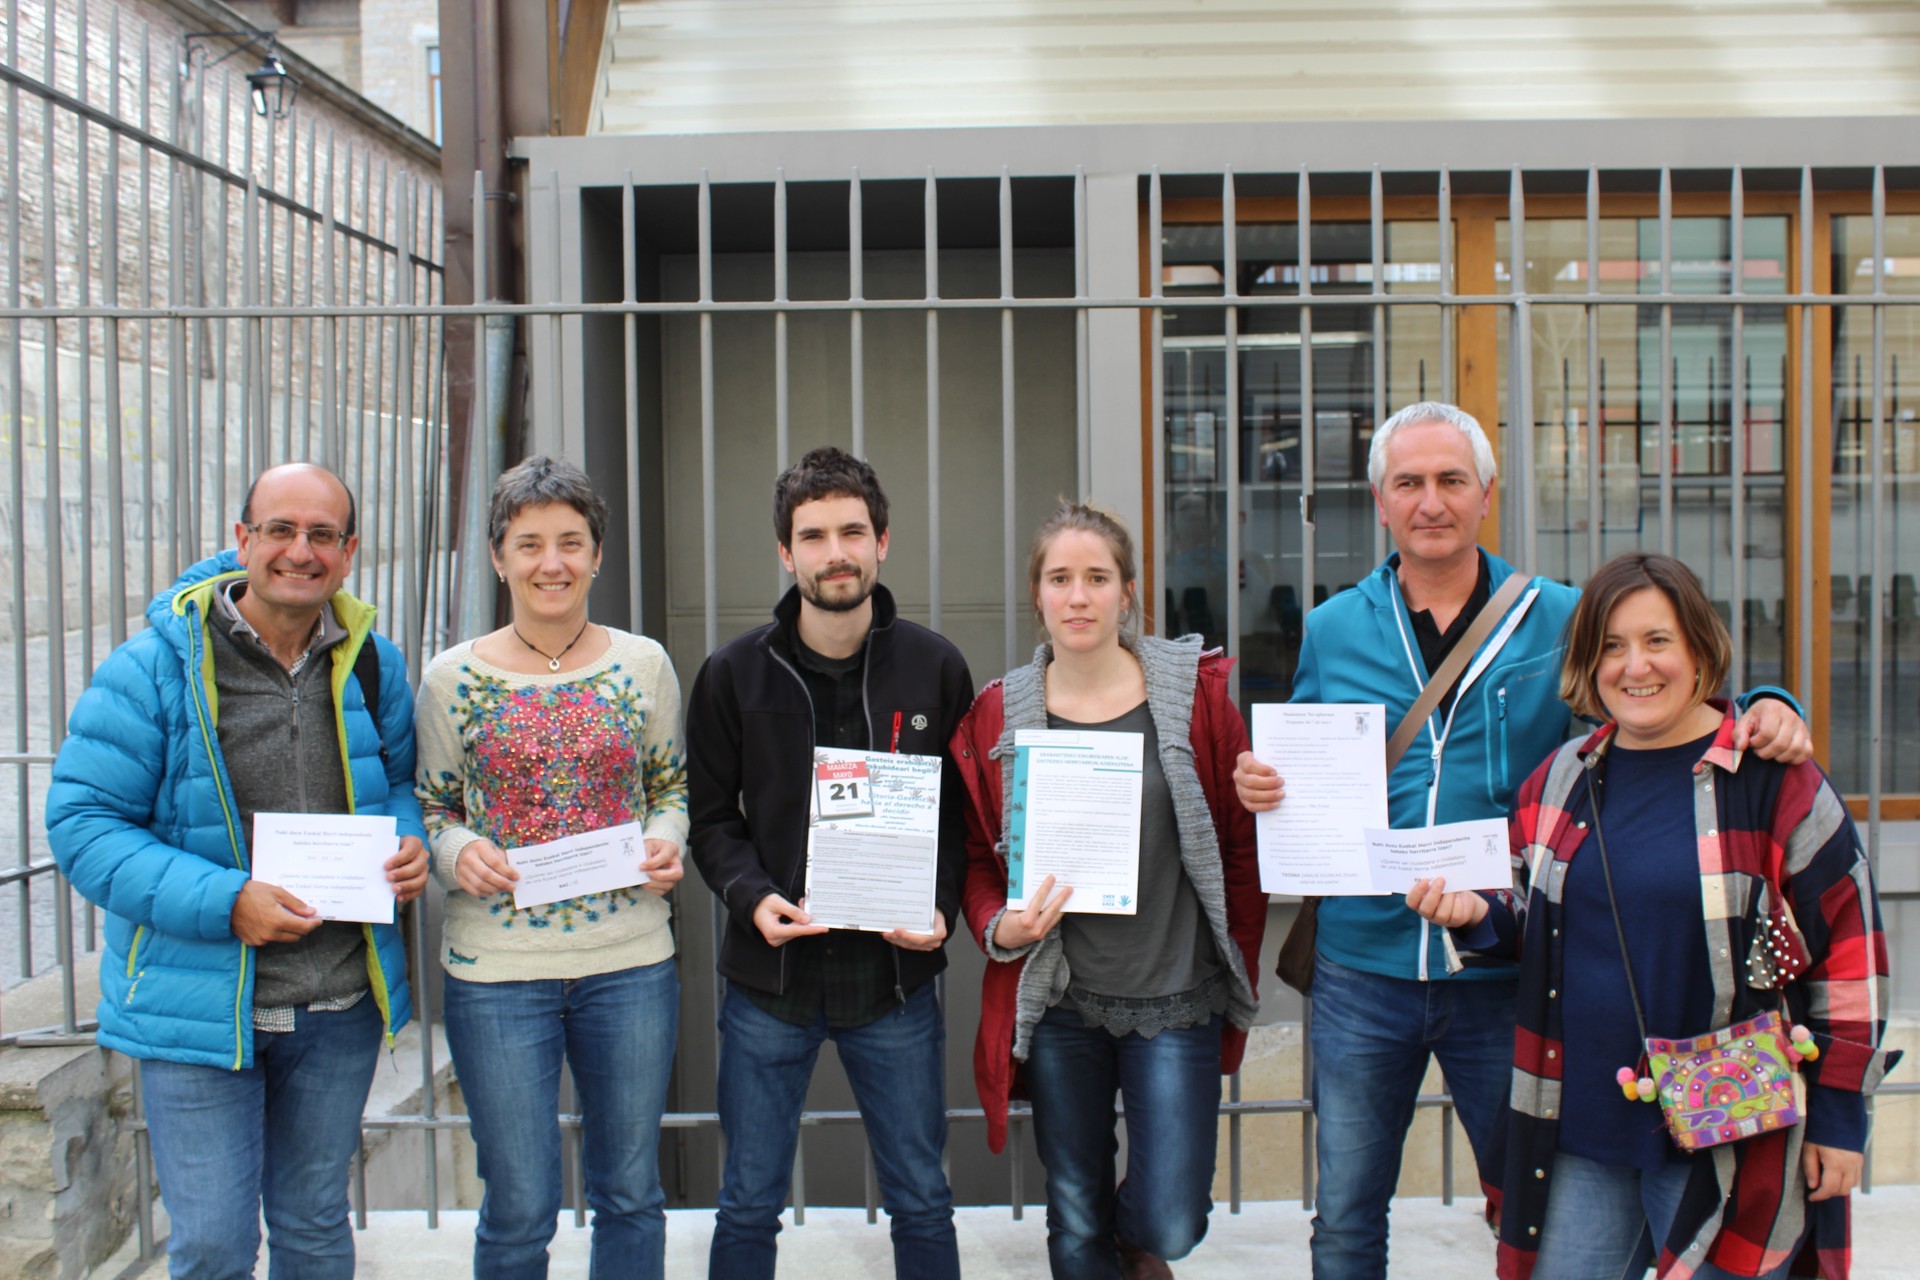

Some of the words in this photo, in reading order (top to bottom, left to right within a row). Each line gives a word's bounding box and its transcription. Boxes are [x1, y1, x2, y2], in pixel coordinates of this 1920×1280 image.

[865, 756, 894, 764] Gasteiz
[827, 762, 858, 771] MAIATZA
[832, 771, 853, 779] MAYO
[829, 782, 859, 800] 21
[894, 801, 925, 809] derecho
